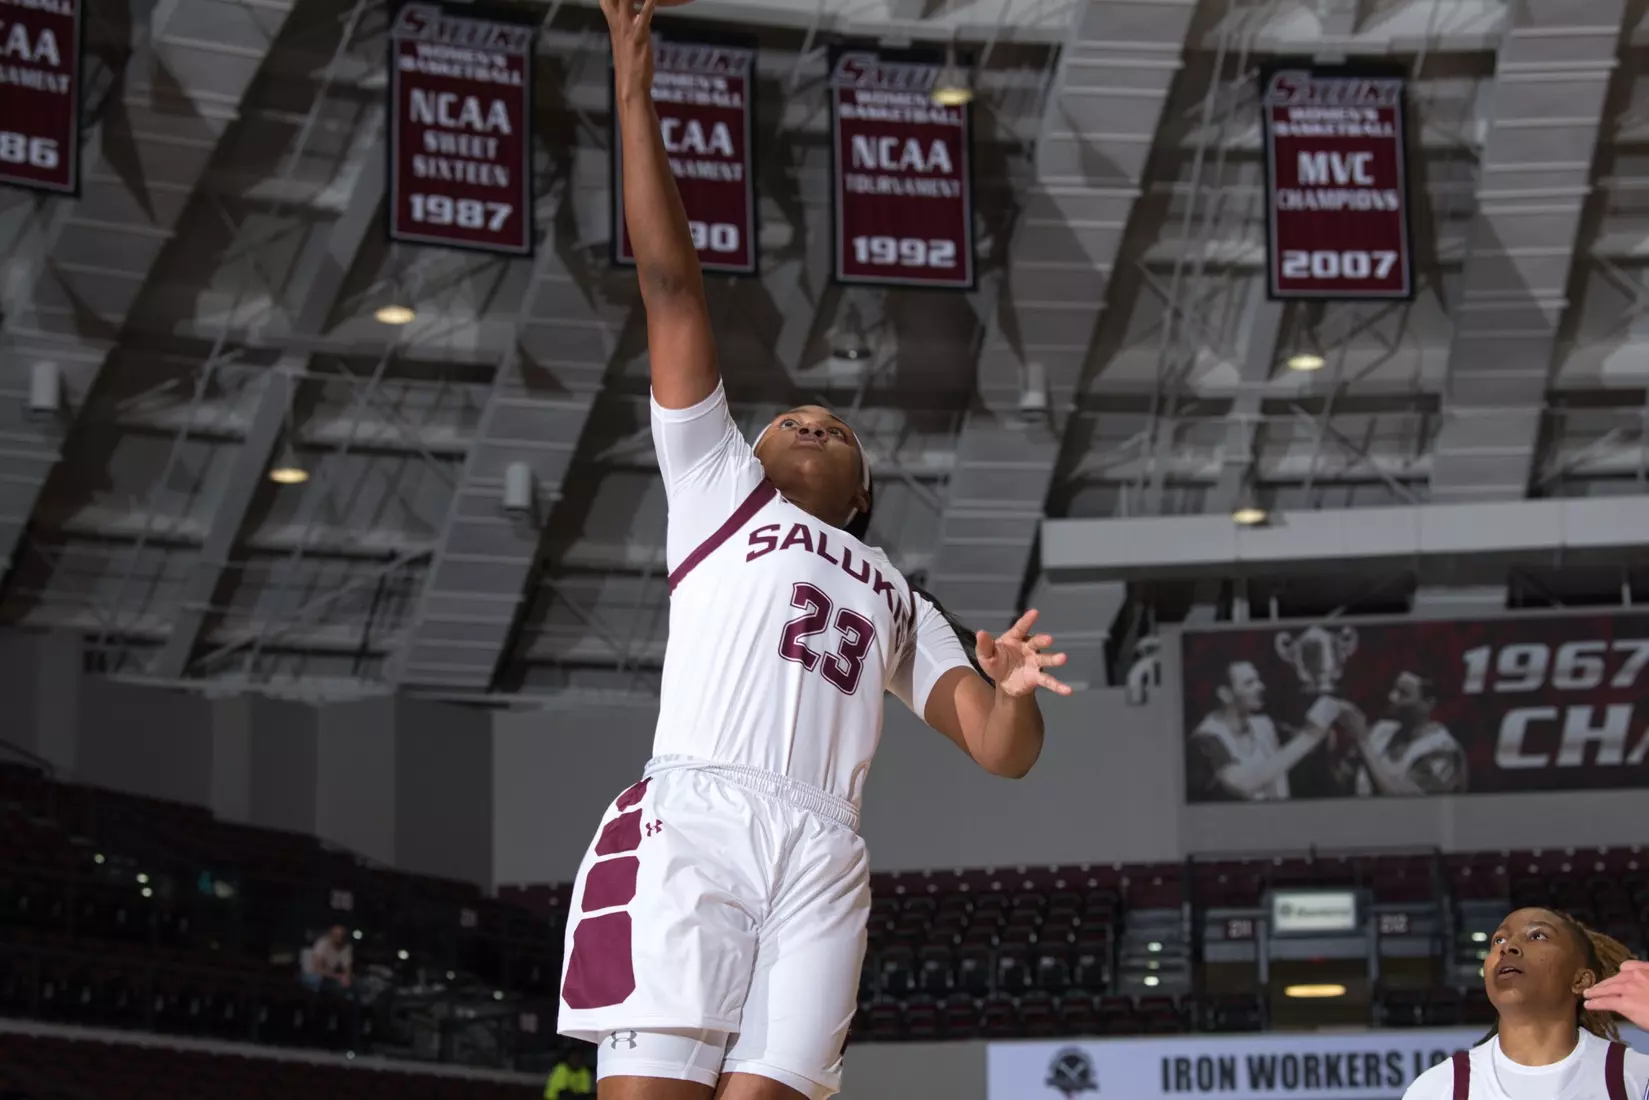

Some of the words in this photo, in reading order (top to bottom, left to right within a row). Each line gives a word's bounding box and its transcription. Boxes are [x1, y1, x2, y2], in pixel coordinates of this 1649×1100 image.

[0, 22, 61, 67] AA
[410, 87, 512, 135] NCAA
[423, 130, 498, 160] SWEET
[661, 116, 734, 157] CAA
[851, 134, 953, 174] NCAA
[412, 153, 509, 188] SIXTEEN
[1298, 151, 1376, 185] MVC
[409, 193, 513, 232] 1987
[1276, 188, 1400, 212] CHAMPIONS
[688, 220, 740, 253] 90
[852, 235, 957, 269] 1992
[1281, 250, 1398, 280] 2007
[778, 581, 876, 695] 23
[1462, 639, 1649, 694] 1967
[1495, 703, 1649, 769] CH
[1161, 1056, 1237, 1092] IRON
[1246, 1050, 1404, 1088] WORKERS
